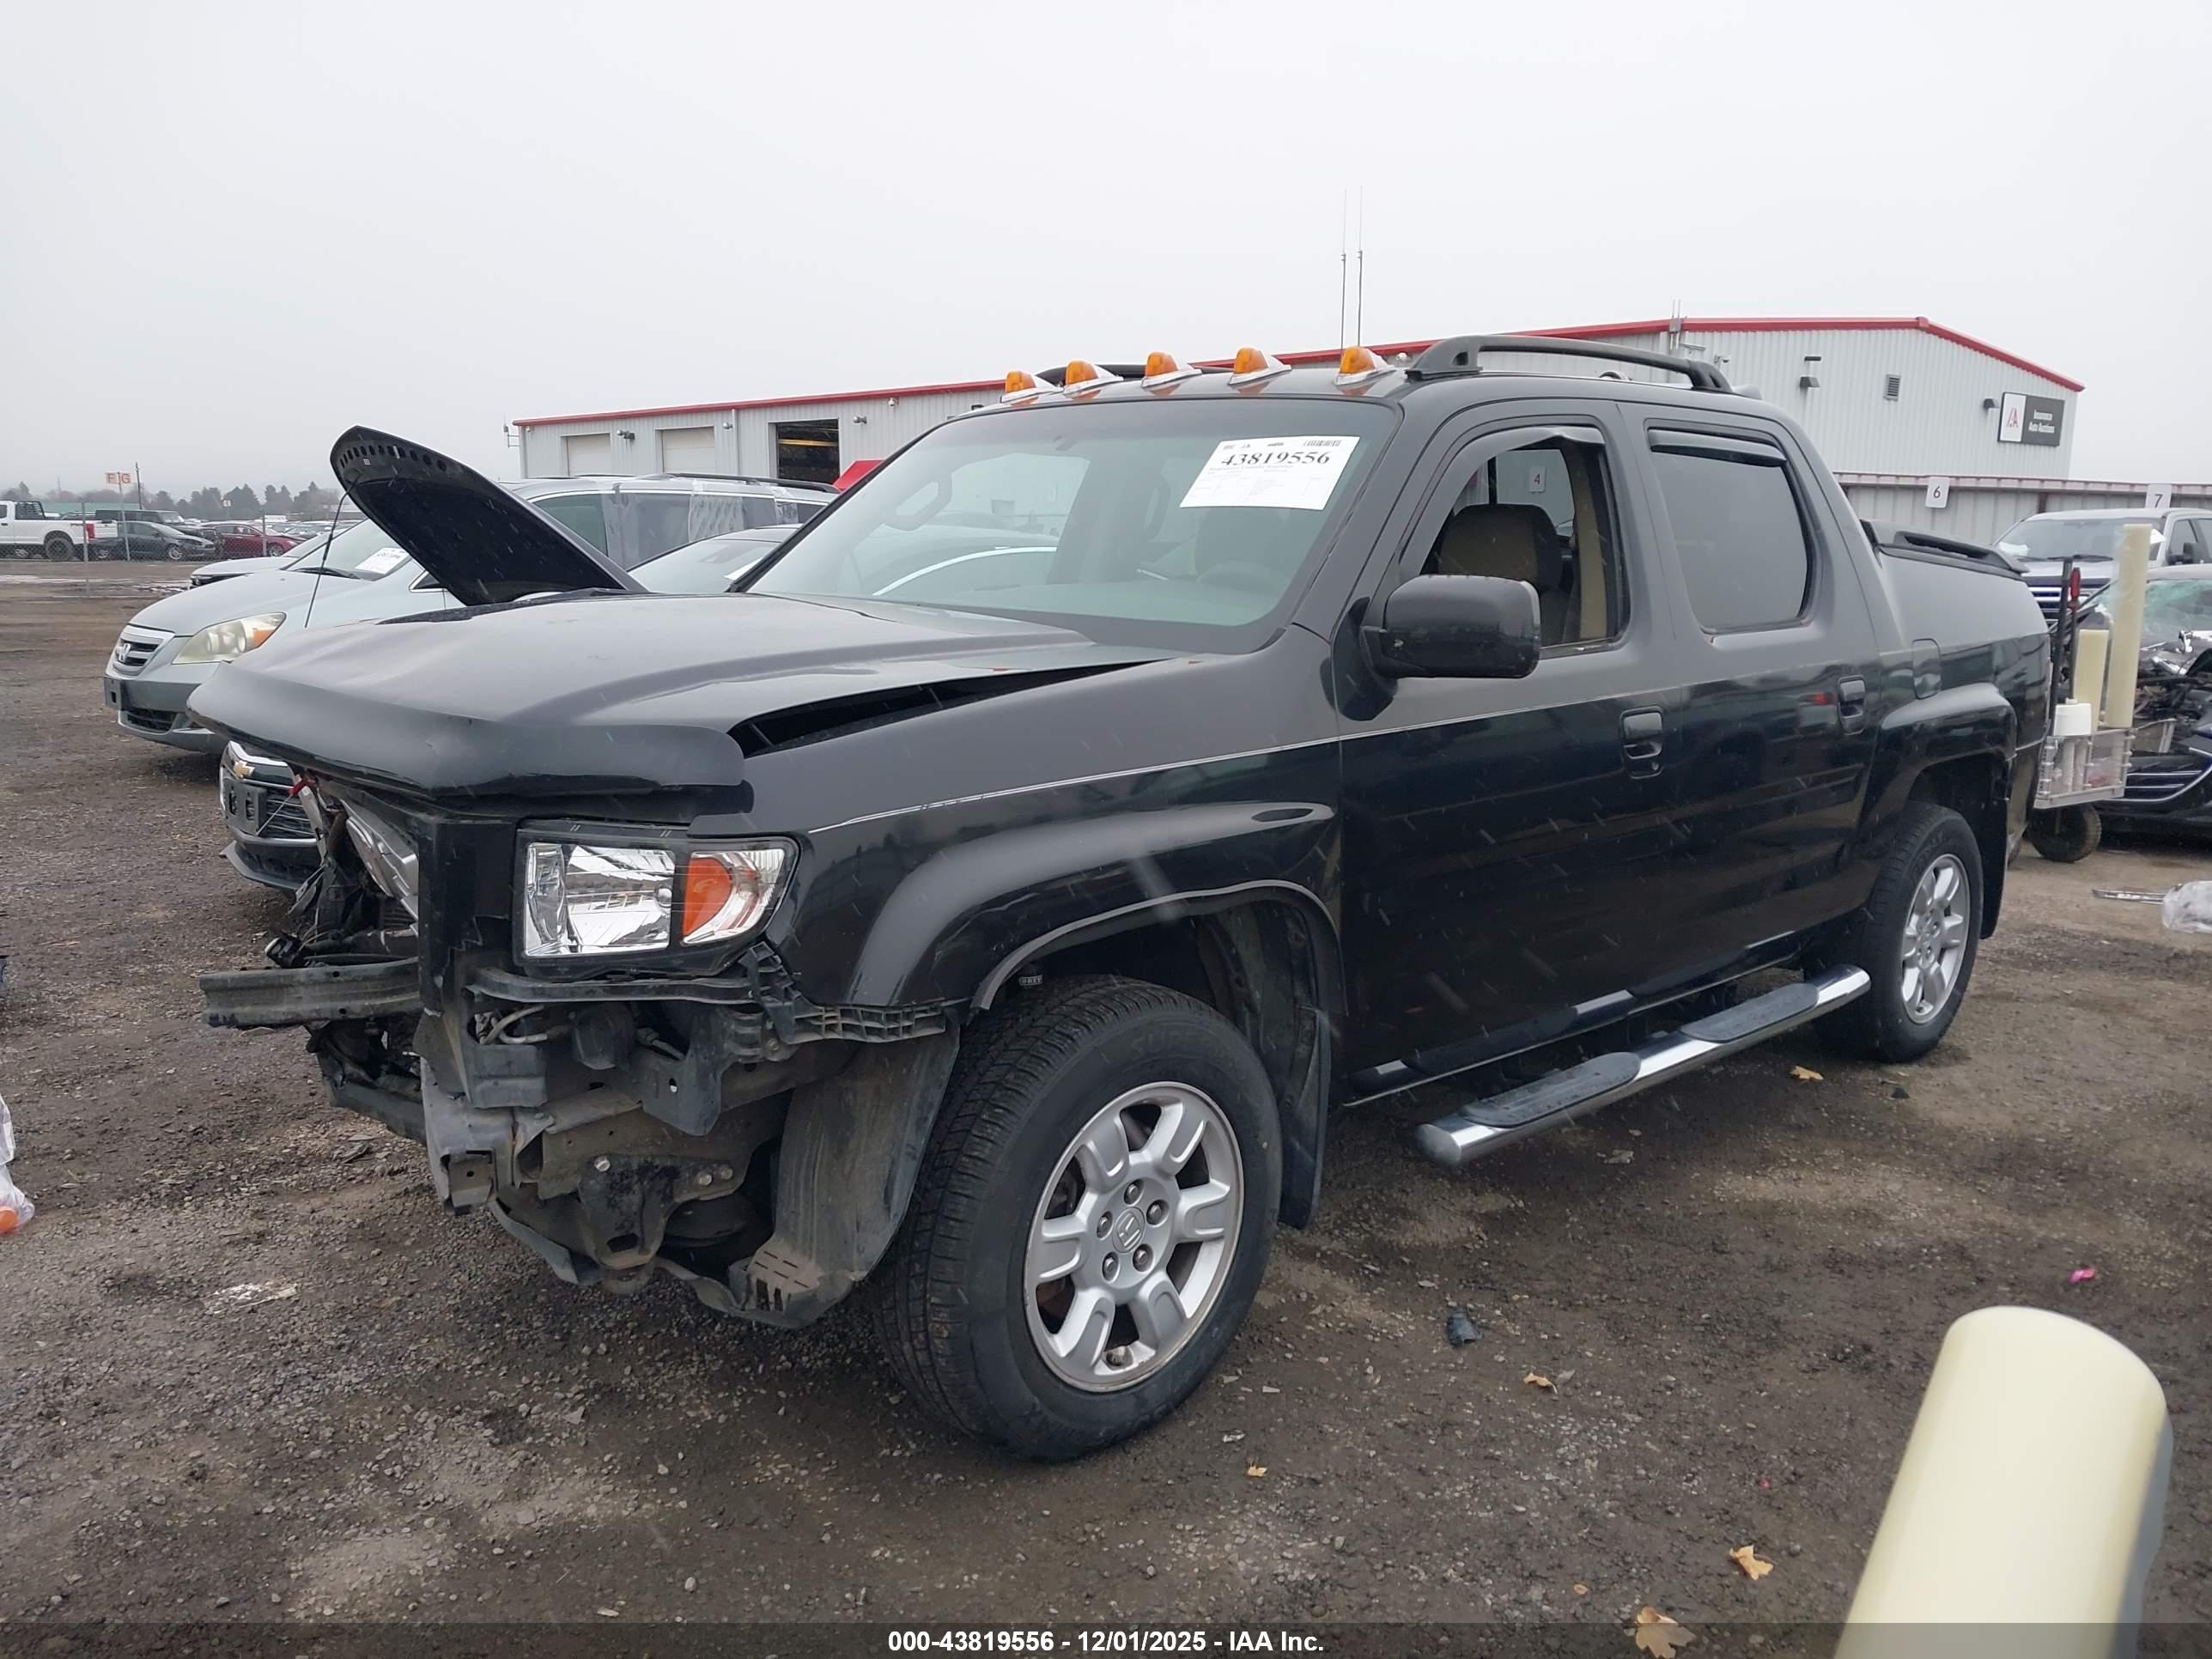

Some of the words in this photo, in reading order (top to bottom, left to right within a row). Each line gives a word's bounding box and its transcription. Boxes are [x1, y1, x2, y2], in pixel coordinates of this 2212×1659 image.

[1221, 451, 1332, 465] 43819556
[1534, 473, 1540, 484] 4
[1933, 486, 1941, 499] 6
[2154, 494, 2163, 507] 7
